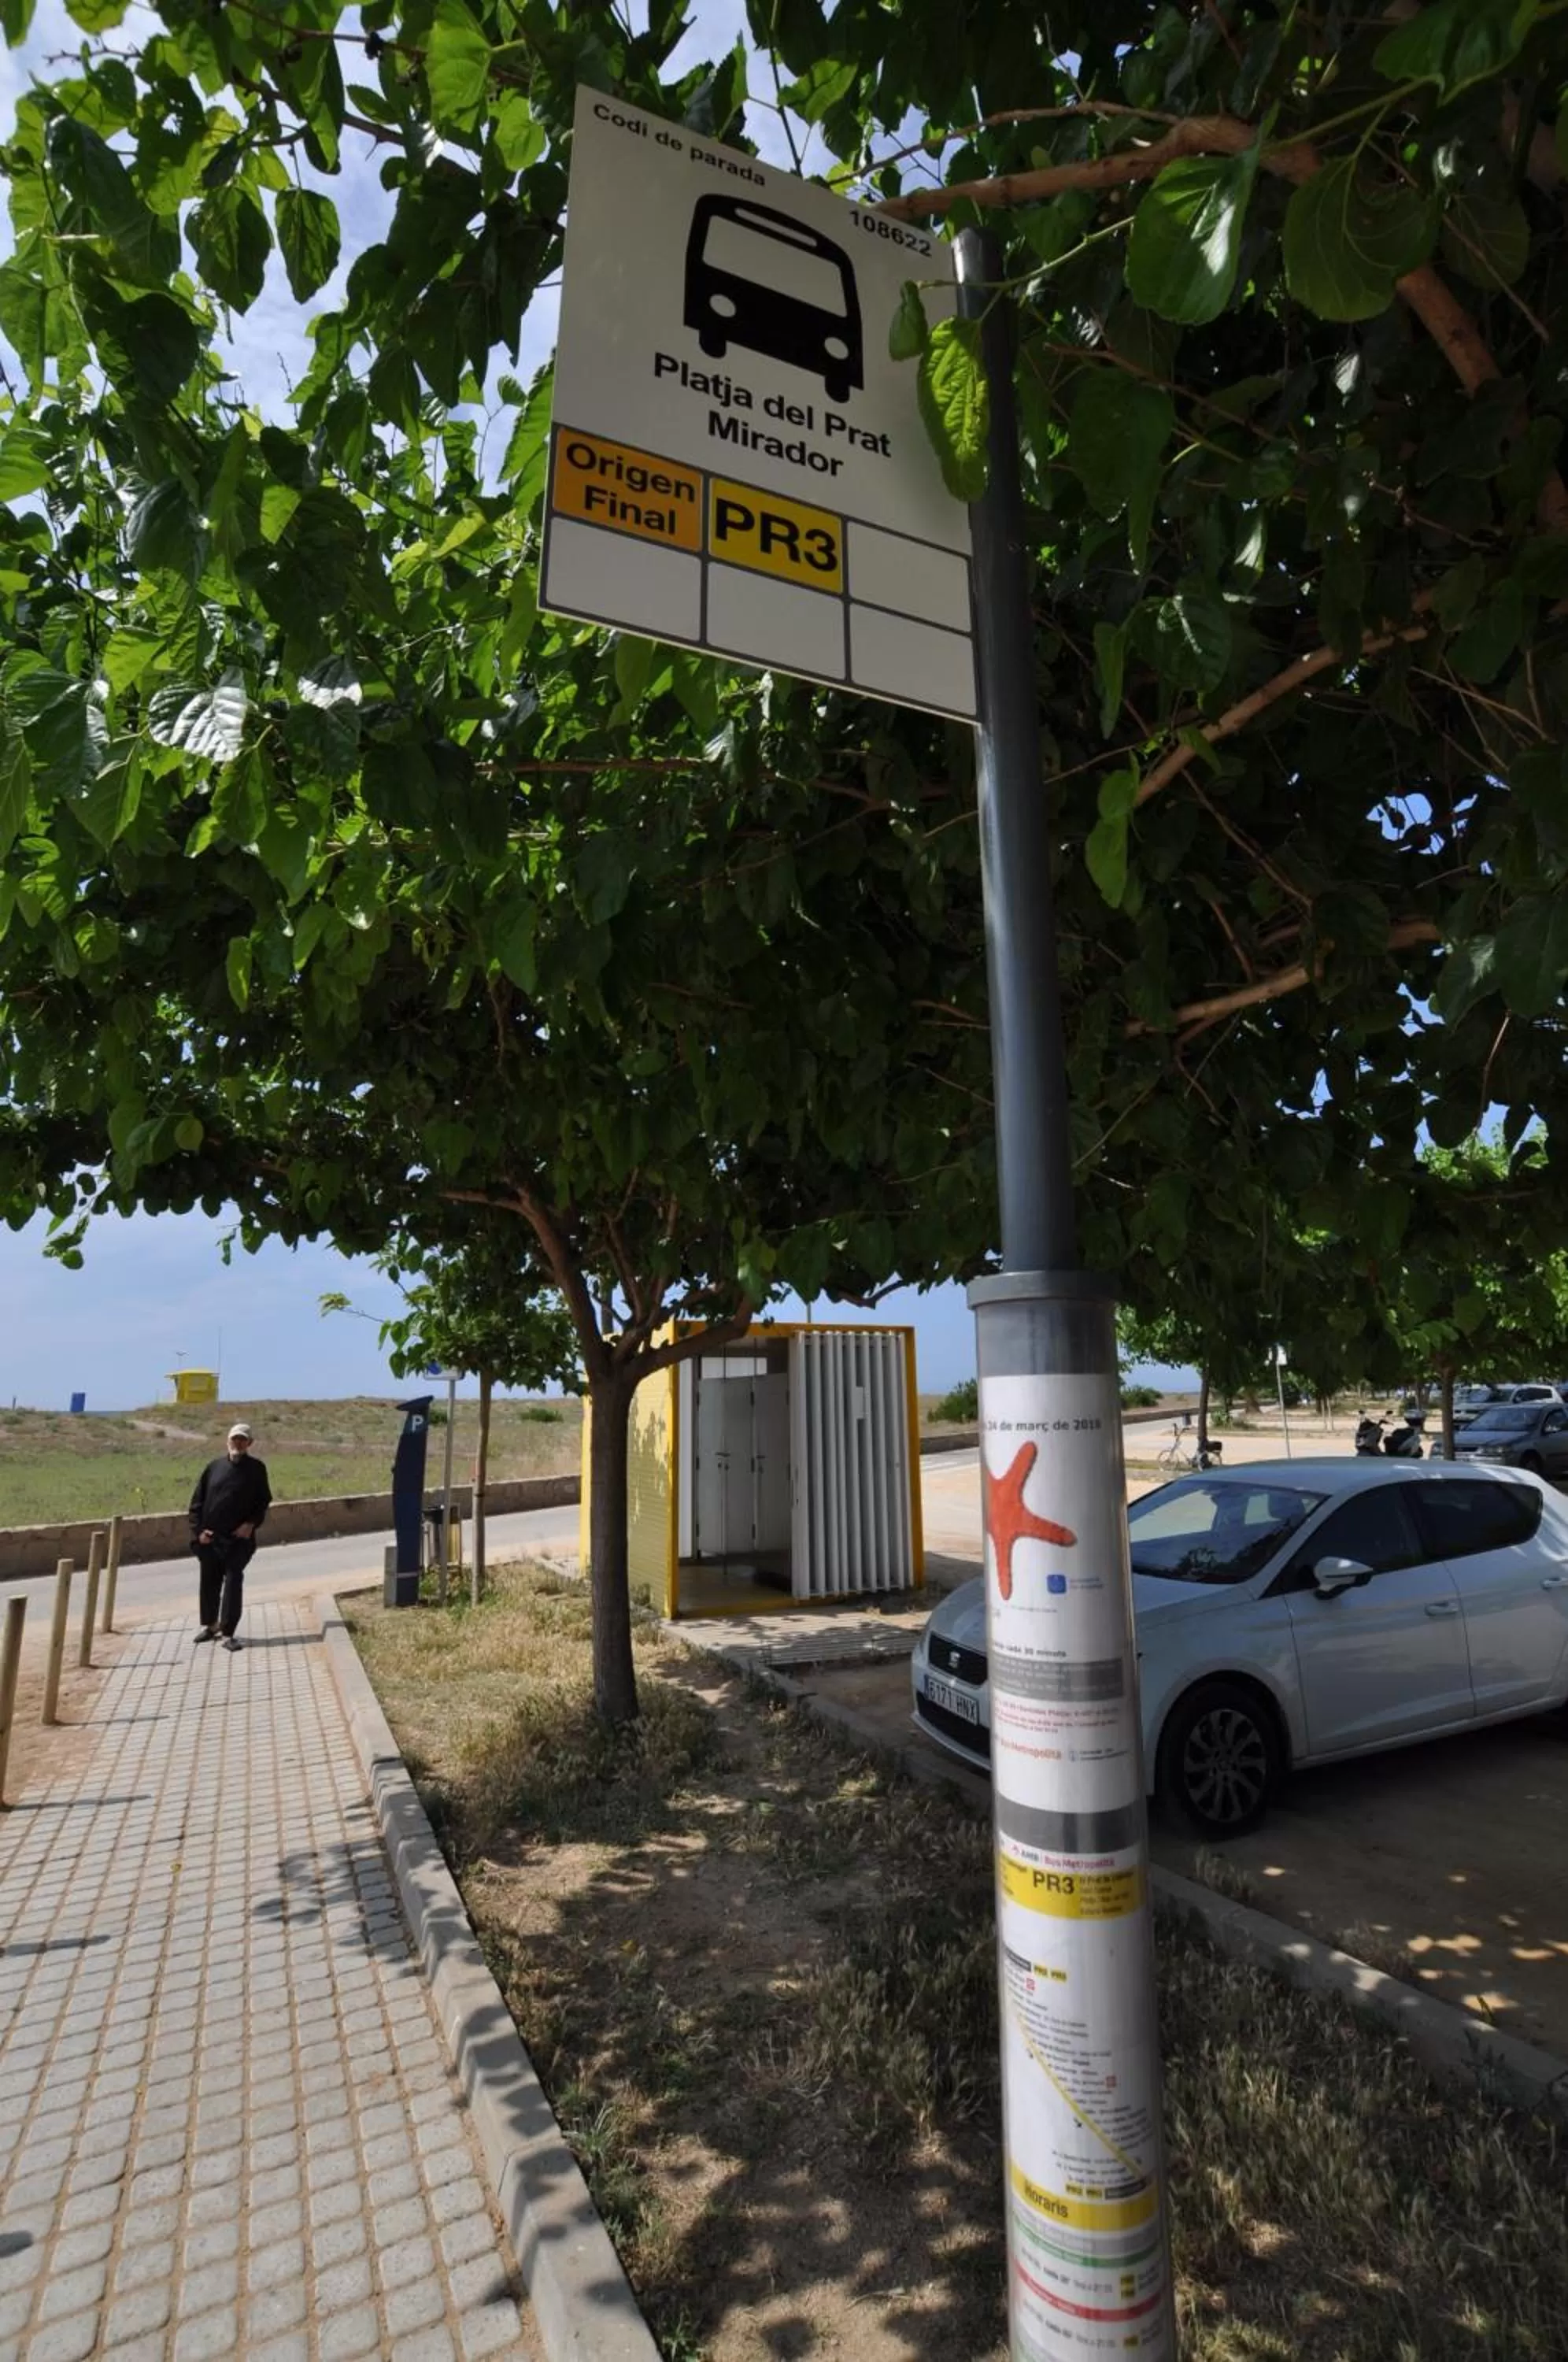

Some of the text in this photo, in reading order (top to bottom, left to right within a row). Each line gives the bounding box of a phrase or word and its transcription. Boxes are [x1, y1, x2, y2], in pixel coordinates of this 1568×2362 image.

[593, 103, 767, 187] Codi de parada
[849, 209, 932, 258] 108622
[653, 352, 891, 458] Platja del Prat
[708, 410, 844, 476] Mirador
[565, 442, 697, 503] Origen
[583, 486, 676, 535] Final
[715, 499, 838, 573] PR3
[412, 1414, 424, 1433] P
[1000, 1419, 1013, 1431] de
[1015, 1420, 1049, 1432] març
[1052, 1418, 1070, 1431] de
[930, 1680, 952, 1709] 6171
[956, 1694, 976, 1722] HNX
[1033, 1870, 1074, 1895] PR3
[1025, 2179, 1069, 2218] Horaris
